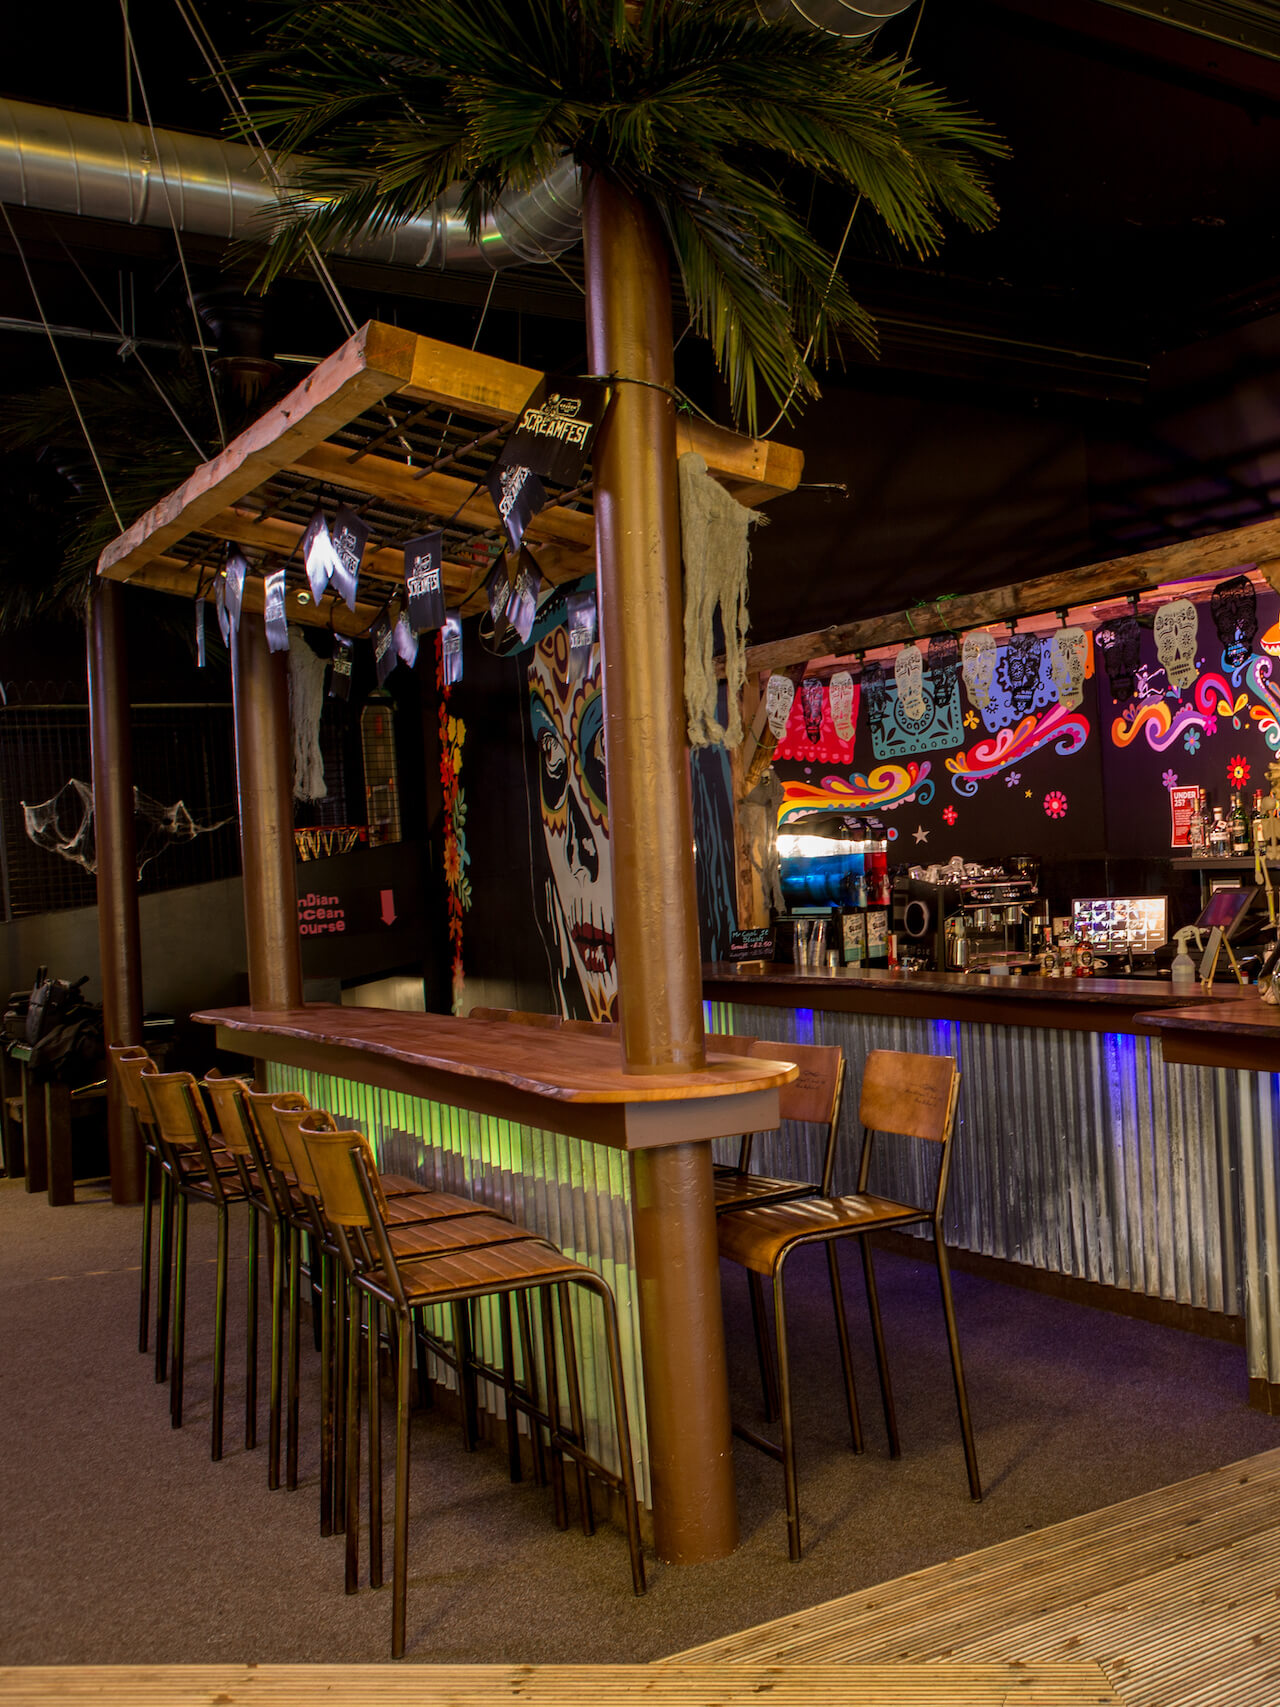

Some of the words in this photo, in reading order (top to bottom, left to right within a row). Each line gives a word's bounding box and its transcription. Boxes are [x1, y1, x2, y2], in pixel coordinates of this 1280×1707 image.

[516, 408, 593, 450] SCREAMFEST
[1173, 791, 1196, 799] UNDER
[297, 893, 339, 907] nDian
[299, 920, 346, 935] ourse
